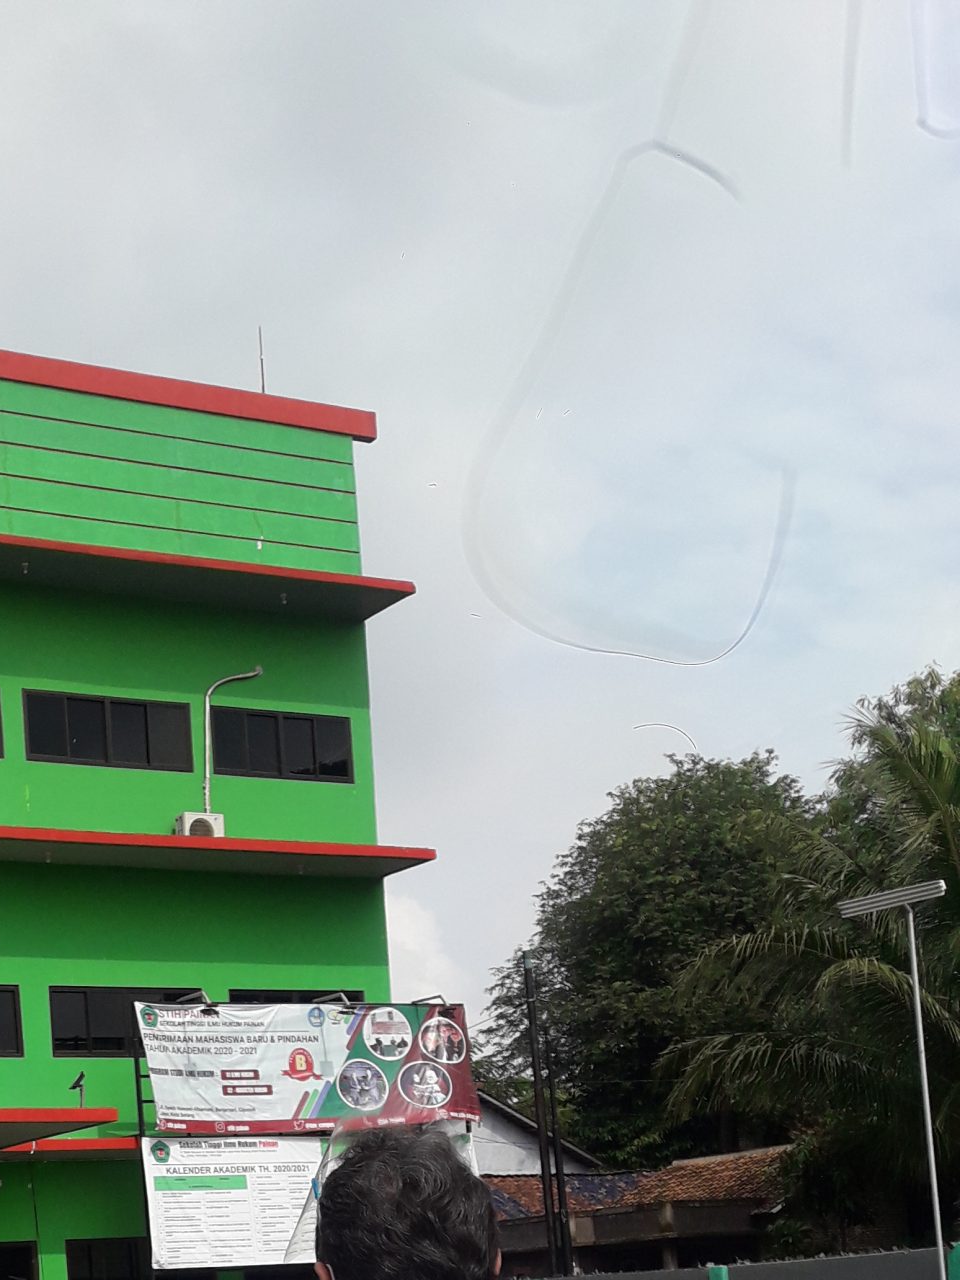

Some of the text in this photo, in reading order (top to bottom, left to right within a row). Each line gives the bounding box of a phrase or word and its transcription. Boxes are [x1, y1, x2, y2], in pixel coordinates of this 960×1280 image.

[195, 1035, 246, 1044] MAHASISWA
[247, 1035, 269, 1044] BARU
[270, 1036, 276, 1044] &
[277, 1035, 320, 1044] PINDAHAN
[171, 1045, 212, 1055] AKADEMIK
[213, 1047, 233, 1056] 2020
[240, 1046, 258, 1055] 2021
[295, 1054, 308, 1071] B
[166, 1164, 311, 1175] KALENDER AKADEMIK TH. 2020/2021
